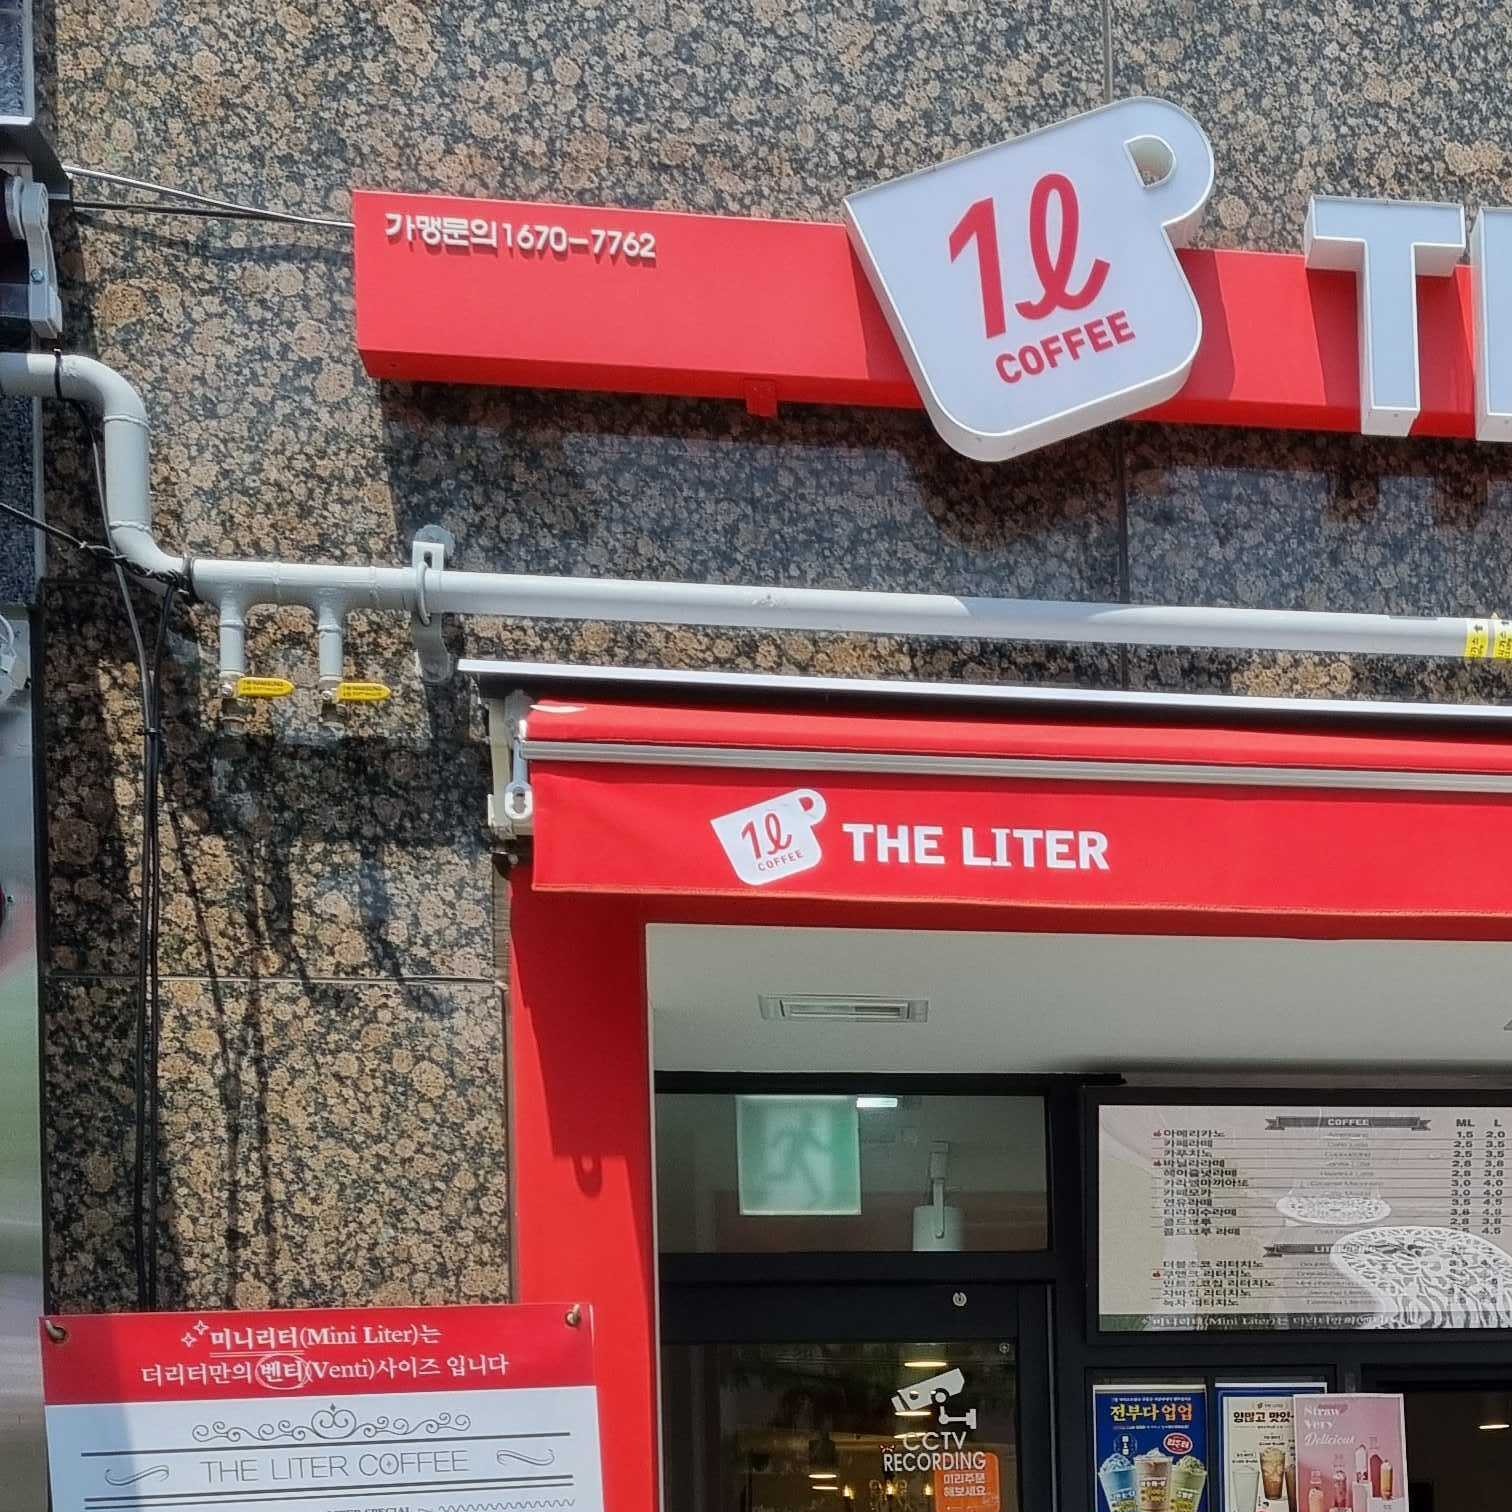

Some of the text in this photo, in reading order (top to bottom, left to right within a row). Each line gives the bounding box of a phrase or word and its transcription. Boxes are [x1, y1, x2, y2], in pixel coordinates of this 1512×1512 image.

[385, 212, 657, 260] 가맹문의 1670-7762
[994, 310, 1136, 385] COFFEE
[842, 823, 1110, 872] THE LITER
[757, 849, 804, 873] COFFEE
[1327, 1118, 1370, 1127] COFFEE
[1456, 1119, 1475, 1127] ML
[1457, 1131, 1474, 1139] 1.5
[1486, 1131, 1505, 1139] 2.0
[211, 1324, 443, 1350] 미니리터(Mini Liter)는
[142, 1361, 253, 1386] 더리터만의
[447, 1354, 509, 1378] 입니다
[1110, 1403, 1193, 1422] 전부다 업업
[902, 1432, 967, 1451] CCTV
[200, 1450, 470, 1482] THE LITER COFFEE
[883, 1451, 987, 1472] RECORDING
